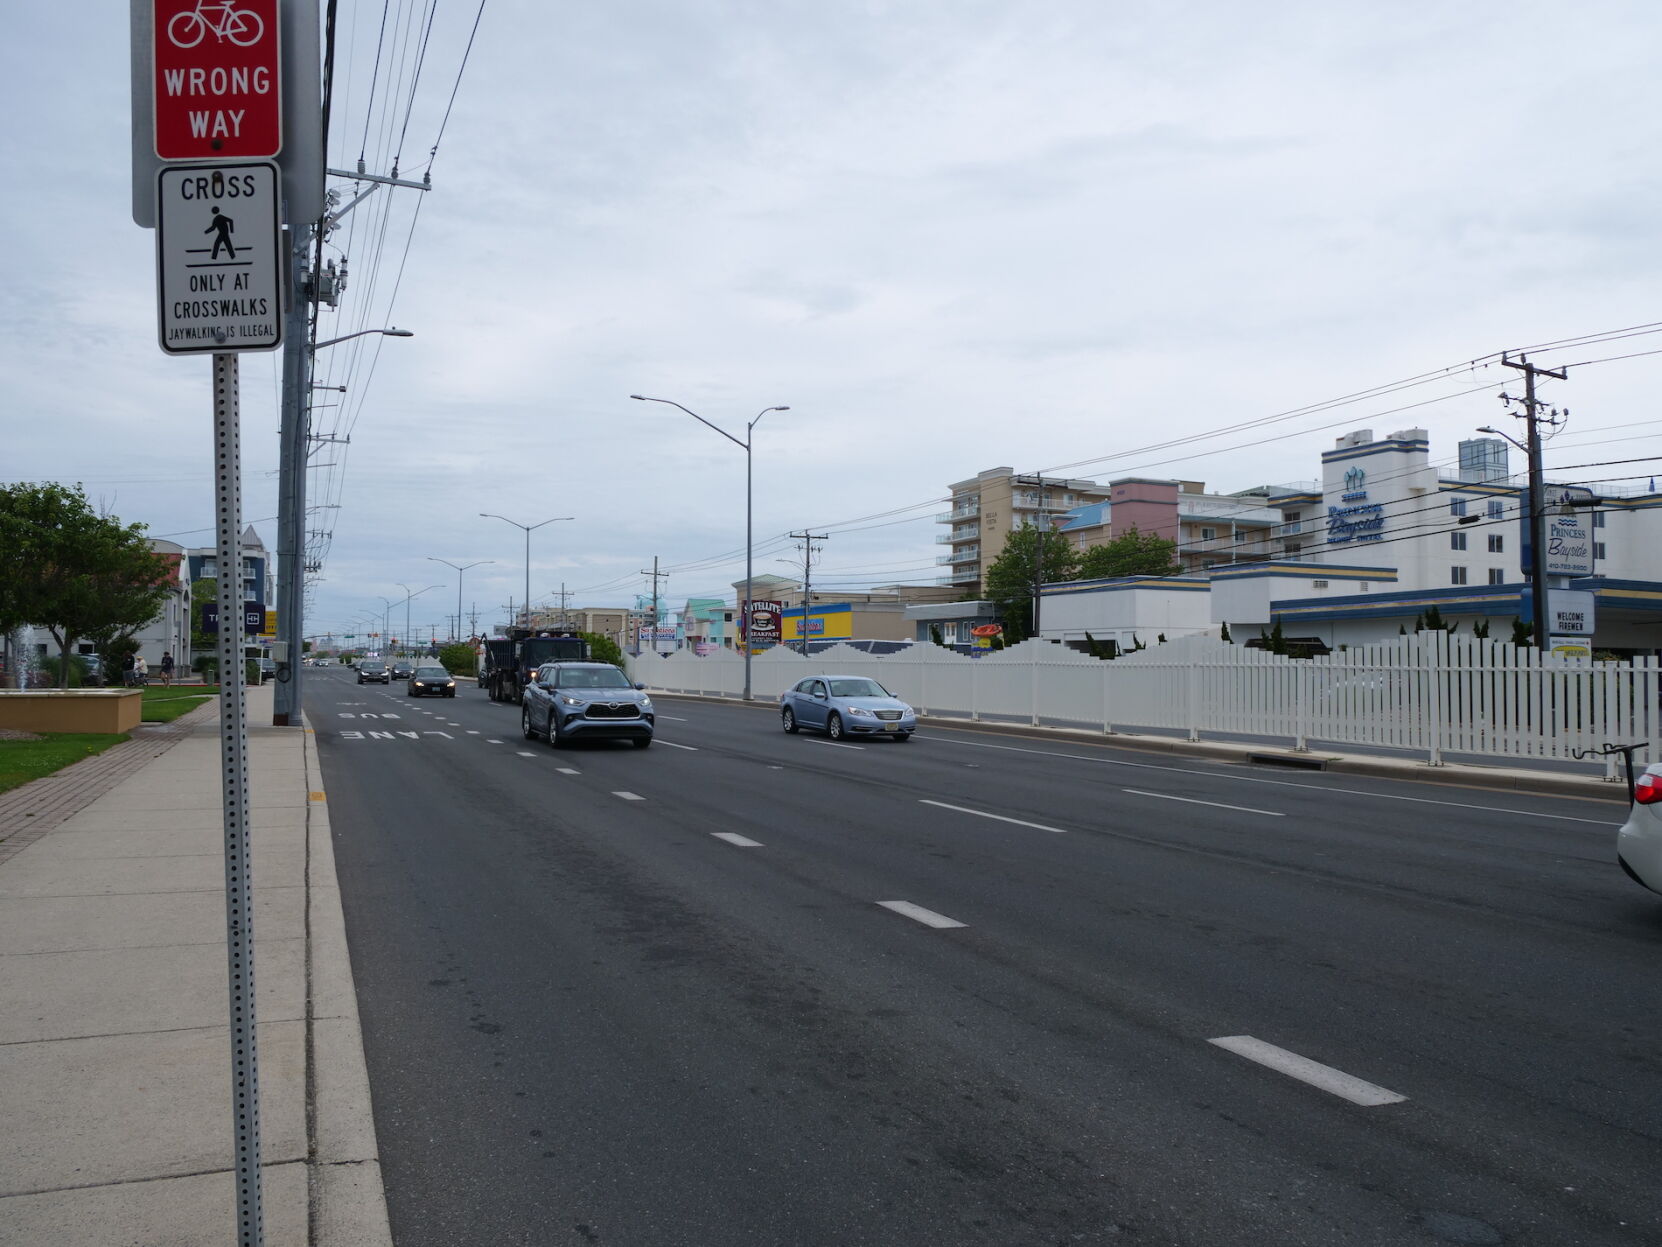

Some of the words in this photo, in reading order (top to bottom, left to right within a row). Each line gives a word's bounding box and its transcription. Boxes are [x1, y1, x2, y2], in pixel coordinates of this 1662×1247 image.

[164, 66, 270, 96] WRONG
[189, 109, 246, 139] WAY
[181, 175, 255, 200] CROSS
[190, 274, 225, 292] ONLY
[234, 273, 250, 291] AT
[174, 298, 267, 319] CROSSWALKS
[226, 325, 235, 338] IS
[239, 324, 275, 337] ILLEGAL
[1550, 523, 1586, 539] PRINCESS
[1548, 537, 1588, 562] Bayside
[1557, 611, 1584, 621] WELCOME
[1559, 621, 1584, 631] FIREMEN
[339, 731, 455, 739] LANE
